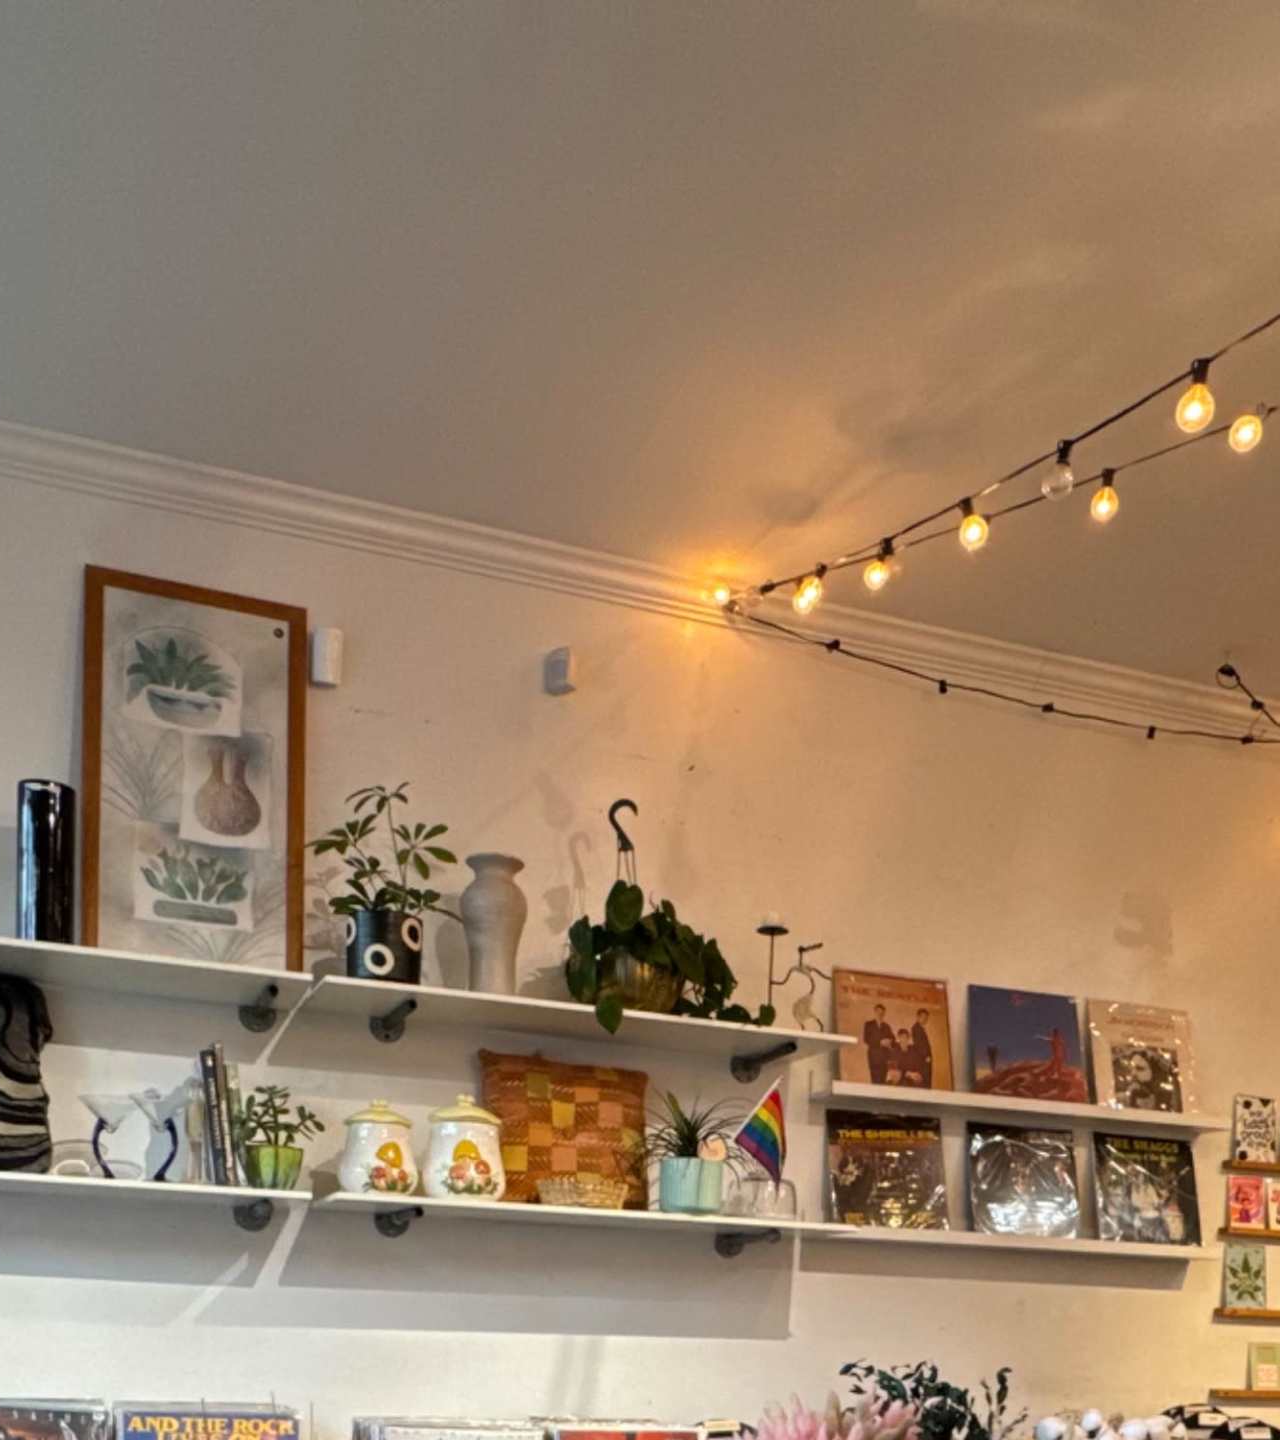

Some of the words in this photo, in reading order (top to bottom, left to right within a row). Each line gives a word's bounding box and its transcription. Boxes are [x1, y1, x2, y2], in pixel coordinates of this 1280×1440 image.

[128, 1416, 179, 1432] AND
[181, 1417, 229, 1434] THE
[232, 1418, 296, 1435] ROCK
